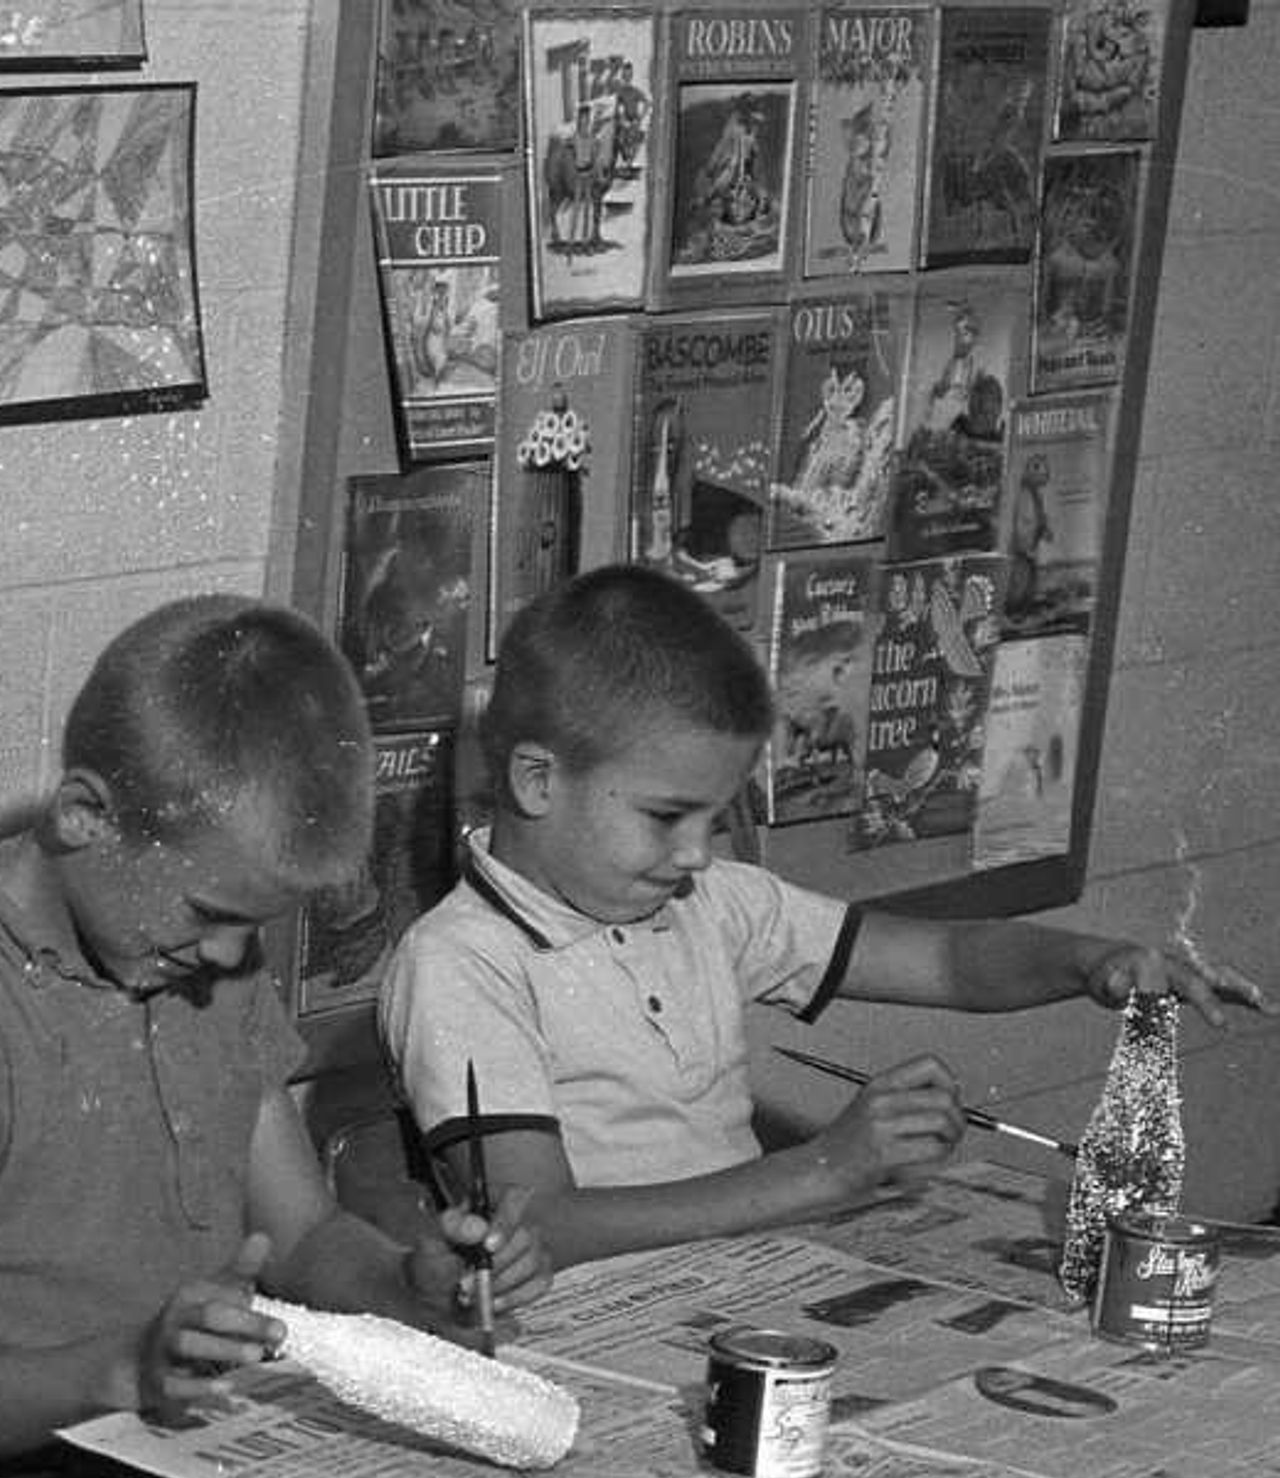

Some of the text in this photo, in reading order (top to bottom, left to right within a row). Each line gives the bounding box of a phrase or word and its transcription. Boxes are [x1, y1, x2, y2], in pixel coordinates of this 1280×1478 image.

[689, 19, 793, 57] ROBINS
[827, 17, 912, 59] MAJOR
[384, 186, 468, 221] LITTLE
[415, 223, 486, 257] CHIP
[793, 305, 853, 342] OTUS
[644, 331, 770, 369] BASCOMBE
[876, 640, 915, 673] the
[870, 678, 937, 710] acorn
[870, 717, 917, 750] tree
